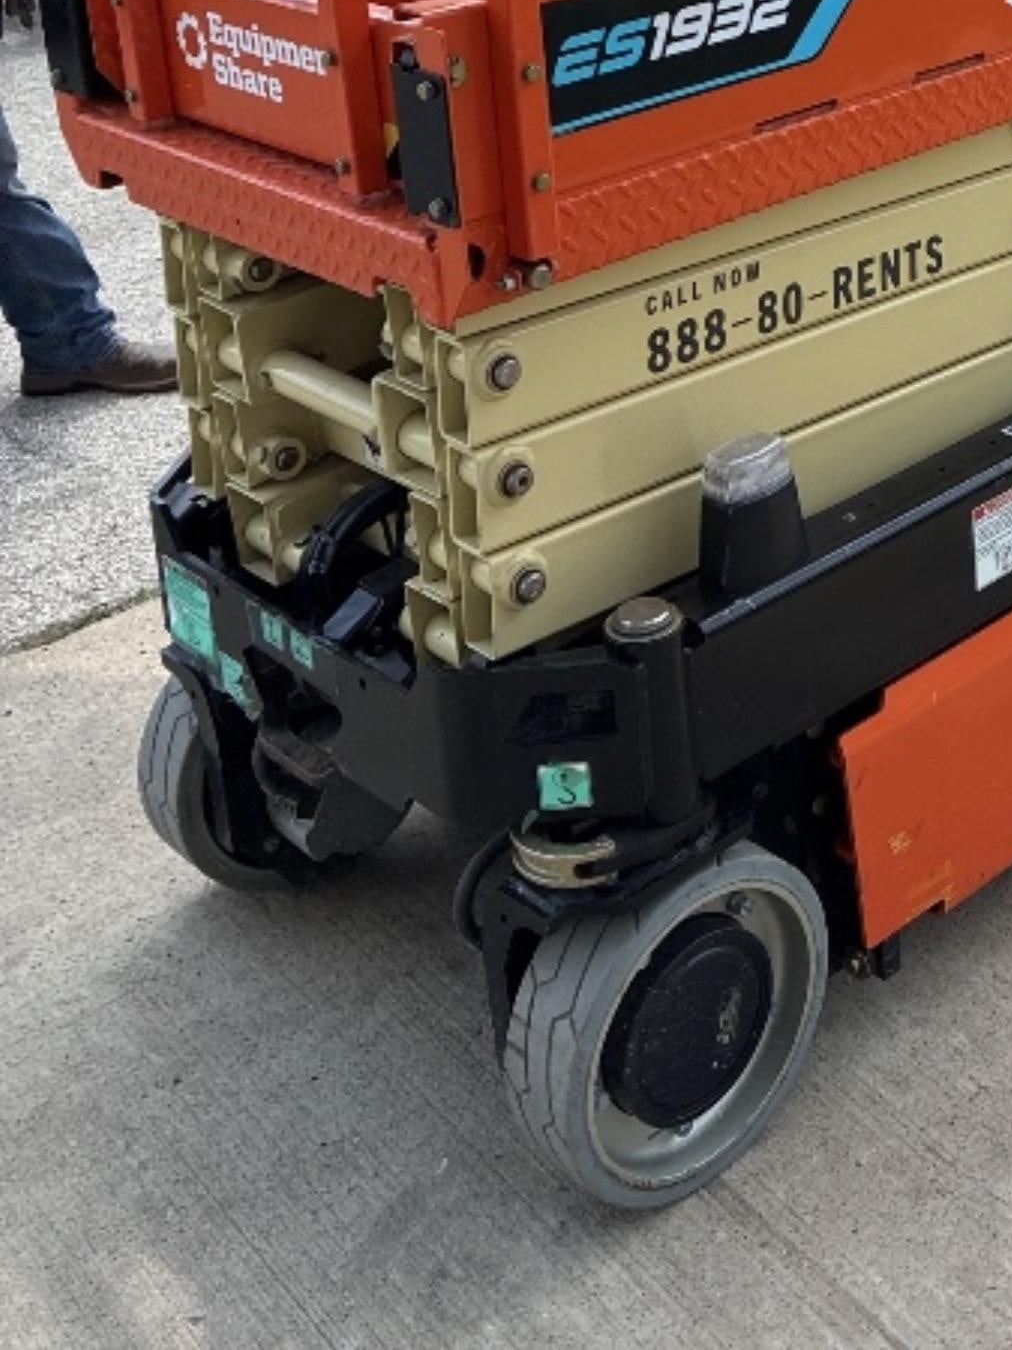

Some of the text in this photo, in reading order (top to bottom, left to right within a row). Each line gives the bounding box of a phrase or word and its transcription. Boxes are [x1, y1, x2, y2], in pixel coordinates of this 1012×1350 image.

[211, 52, 284, 104] Share
[644, 260, 761, 317] CALL NOW
[646, 233, 944, 374] 888-80-RENTS
